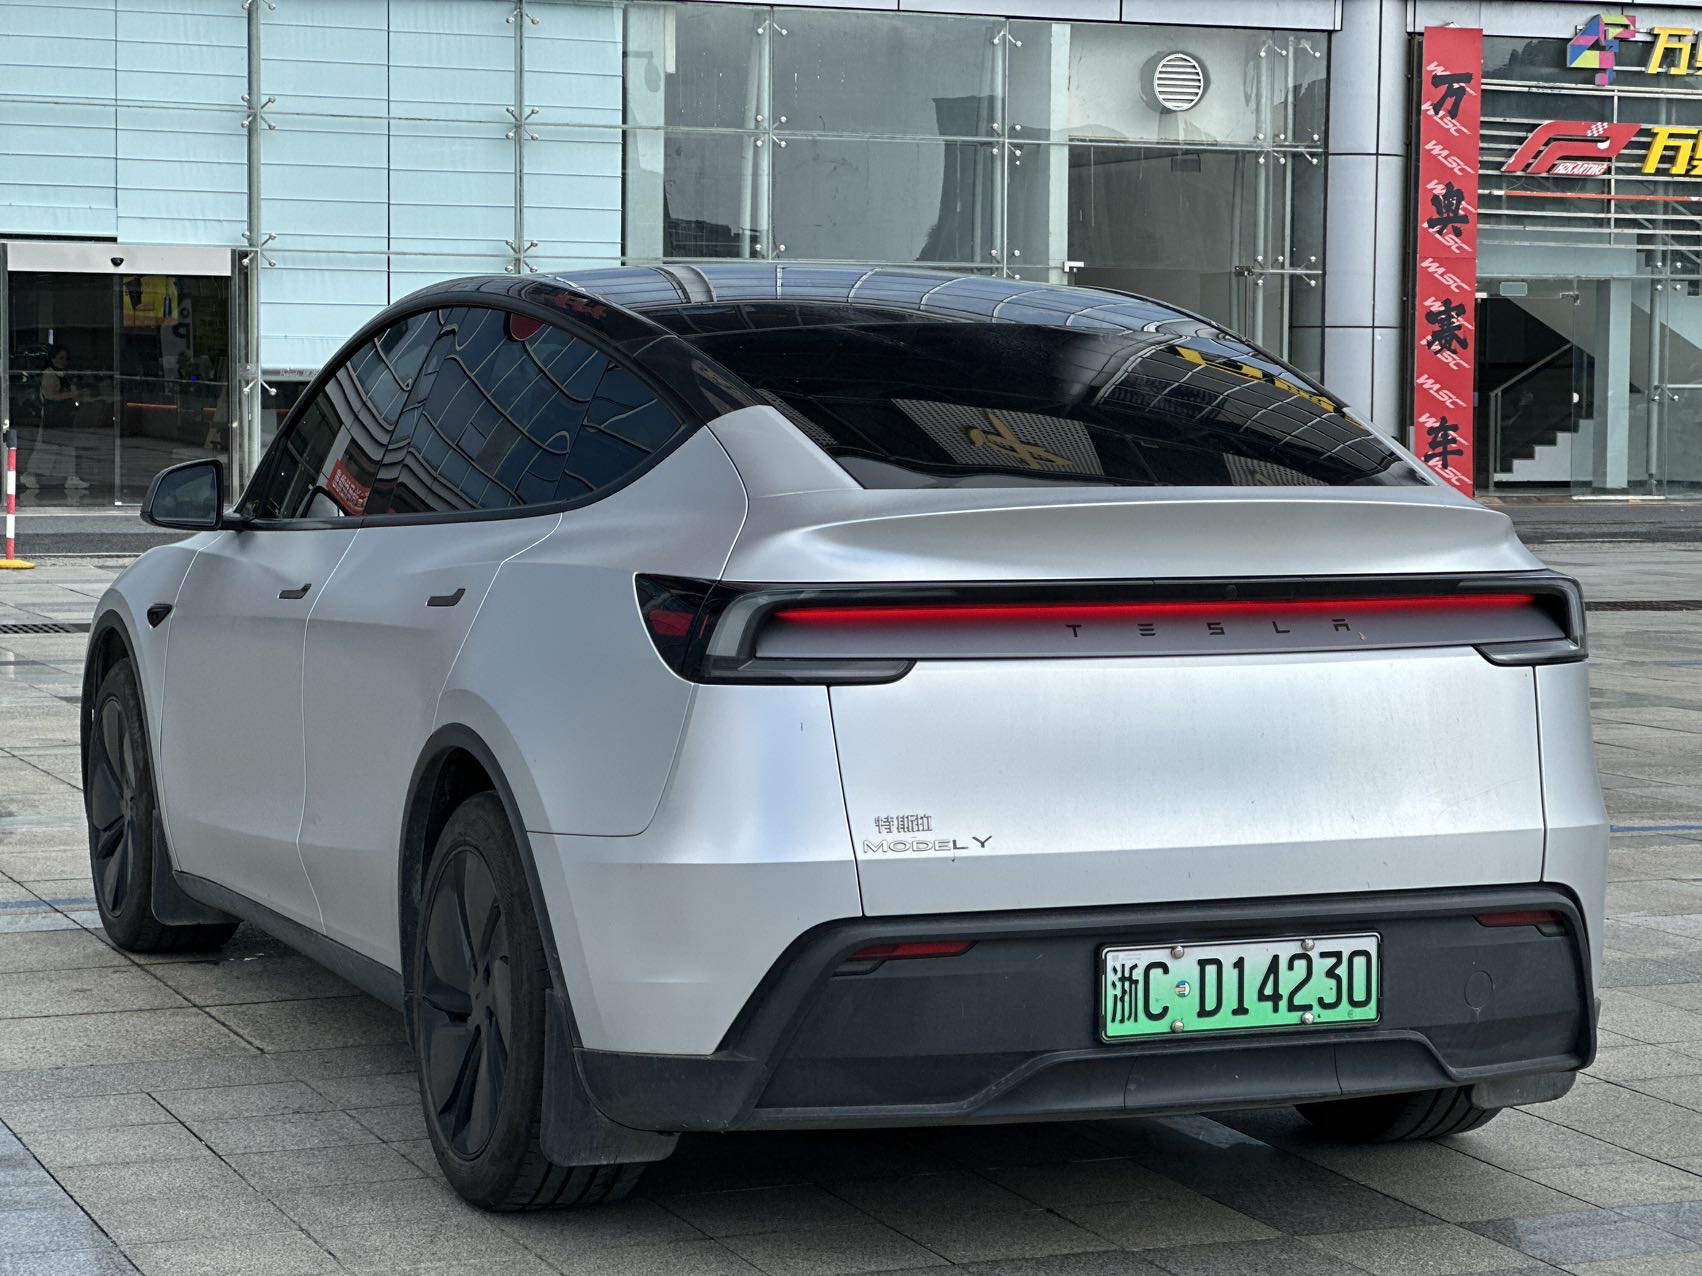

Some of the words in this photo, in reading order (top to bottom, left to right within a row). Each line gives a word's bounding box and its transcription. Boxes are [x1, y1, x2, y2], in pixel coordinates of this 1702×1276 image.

[1646, 26, 1702, 75] 万
[1641, 127, 1702, 175] 万
[1065, 618, 1350, 638] TESLA
[874, 814, 933, 834] 特斯拉
